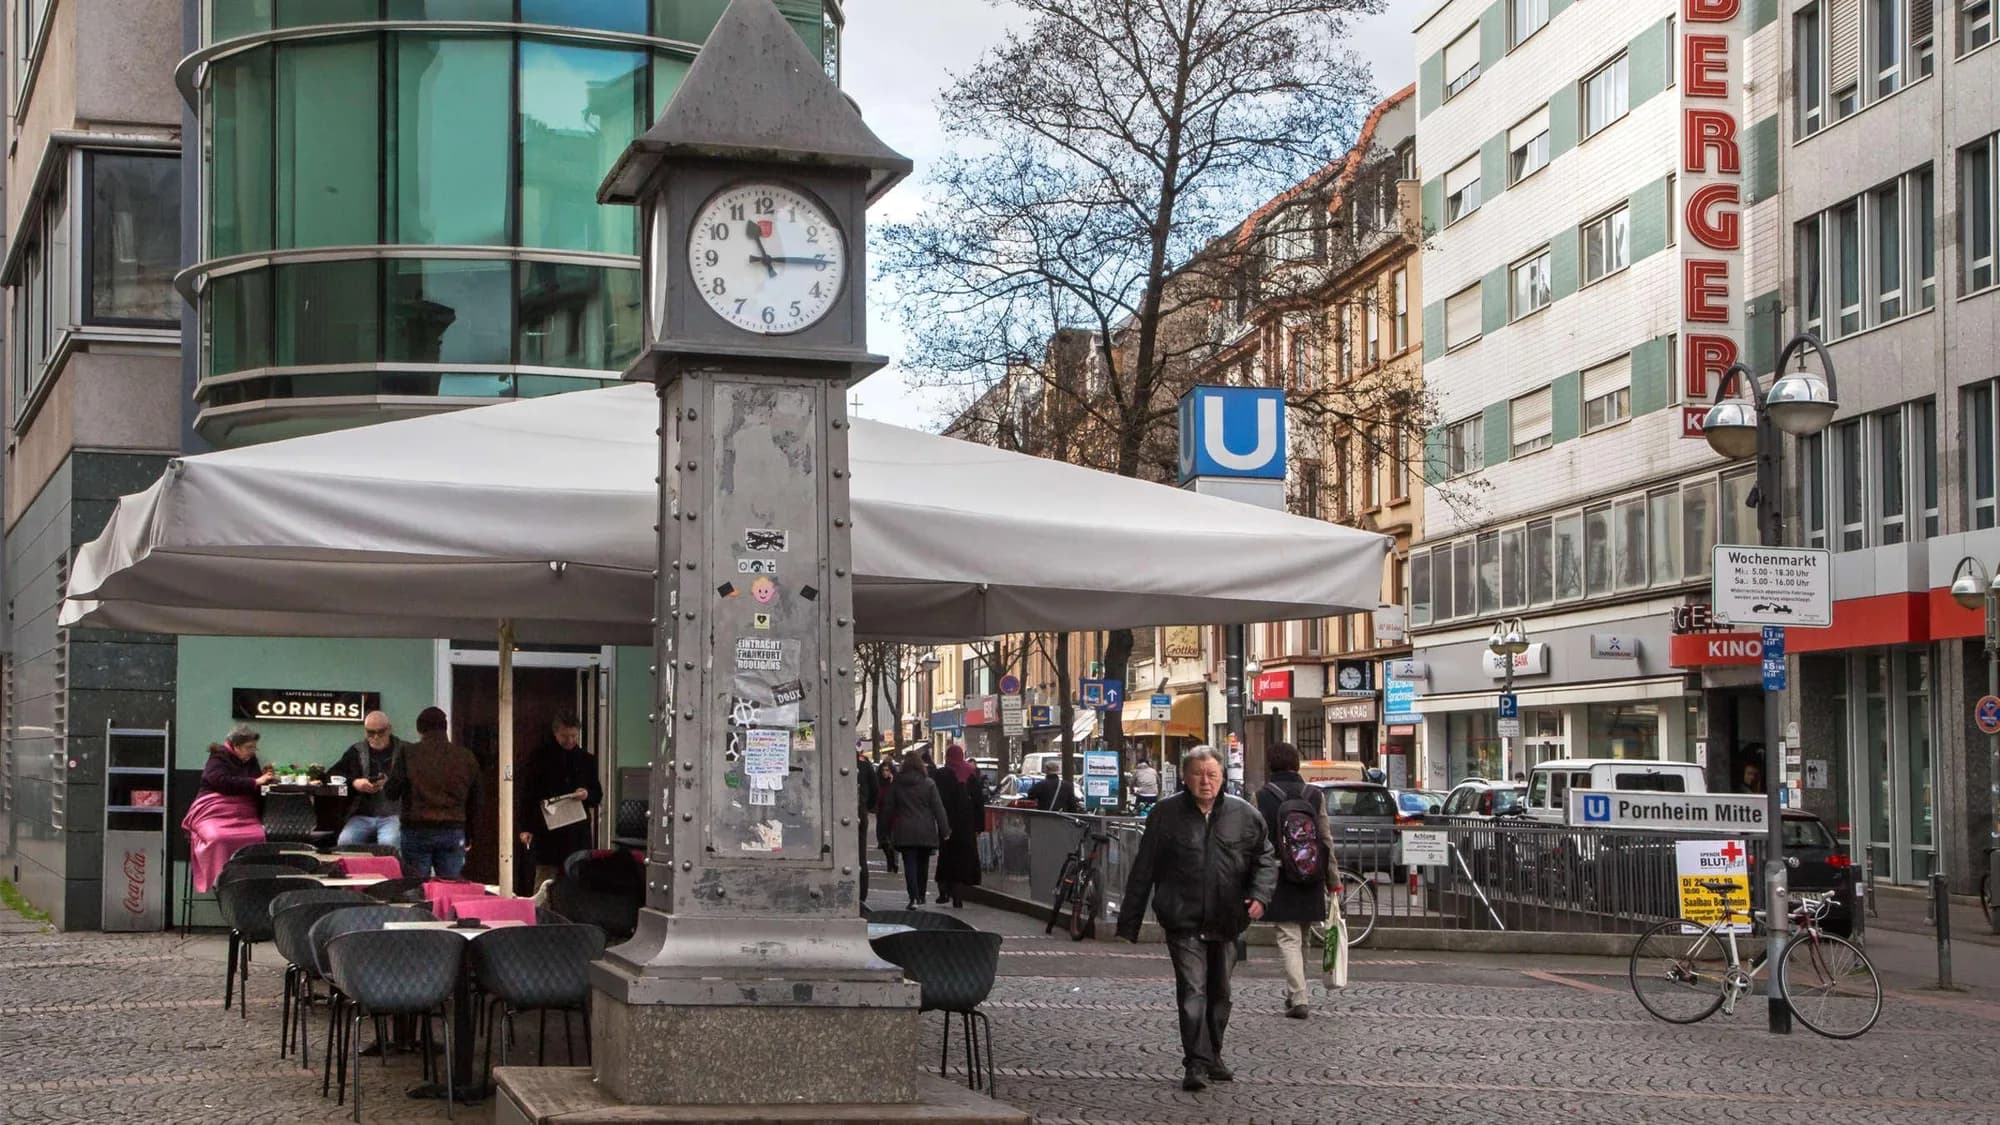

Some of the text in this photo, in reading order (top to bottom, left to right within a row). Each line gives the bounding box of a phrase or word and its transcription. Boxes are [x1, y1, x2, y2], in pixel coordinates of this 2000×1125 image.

[730, 204, 744, 221] 11
[755, 197, 774, 215] 12
[789, 207, 796, 223] 1
[709, 223, 729, 241] 10
[807, 226, 818, 243] 2
[705, 249, 719, 267] 9
[712, 277, 726, 295] 8
[808, 281, 822, 299] 4
[734, 299, 748, 314] 7
[789, 301, 801, 317] 5
[761, 307, 775, 324] 6
[1204, 396, 1277, 470] U
[1729, 552, 1816, 567] Wochenmarkt
[1752, 578, 1768, 586] 5.00
[1708, 640, 1763, 657] KINO
[1493, 655, 1528, 669] TARGBANK
[257, 700, 360, 717] CORNERS
[1588, 796, 1606, 818] U
[1715, 804, 1762, 823] Mitte
[1700, 858, 1727, 867] BLUT
